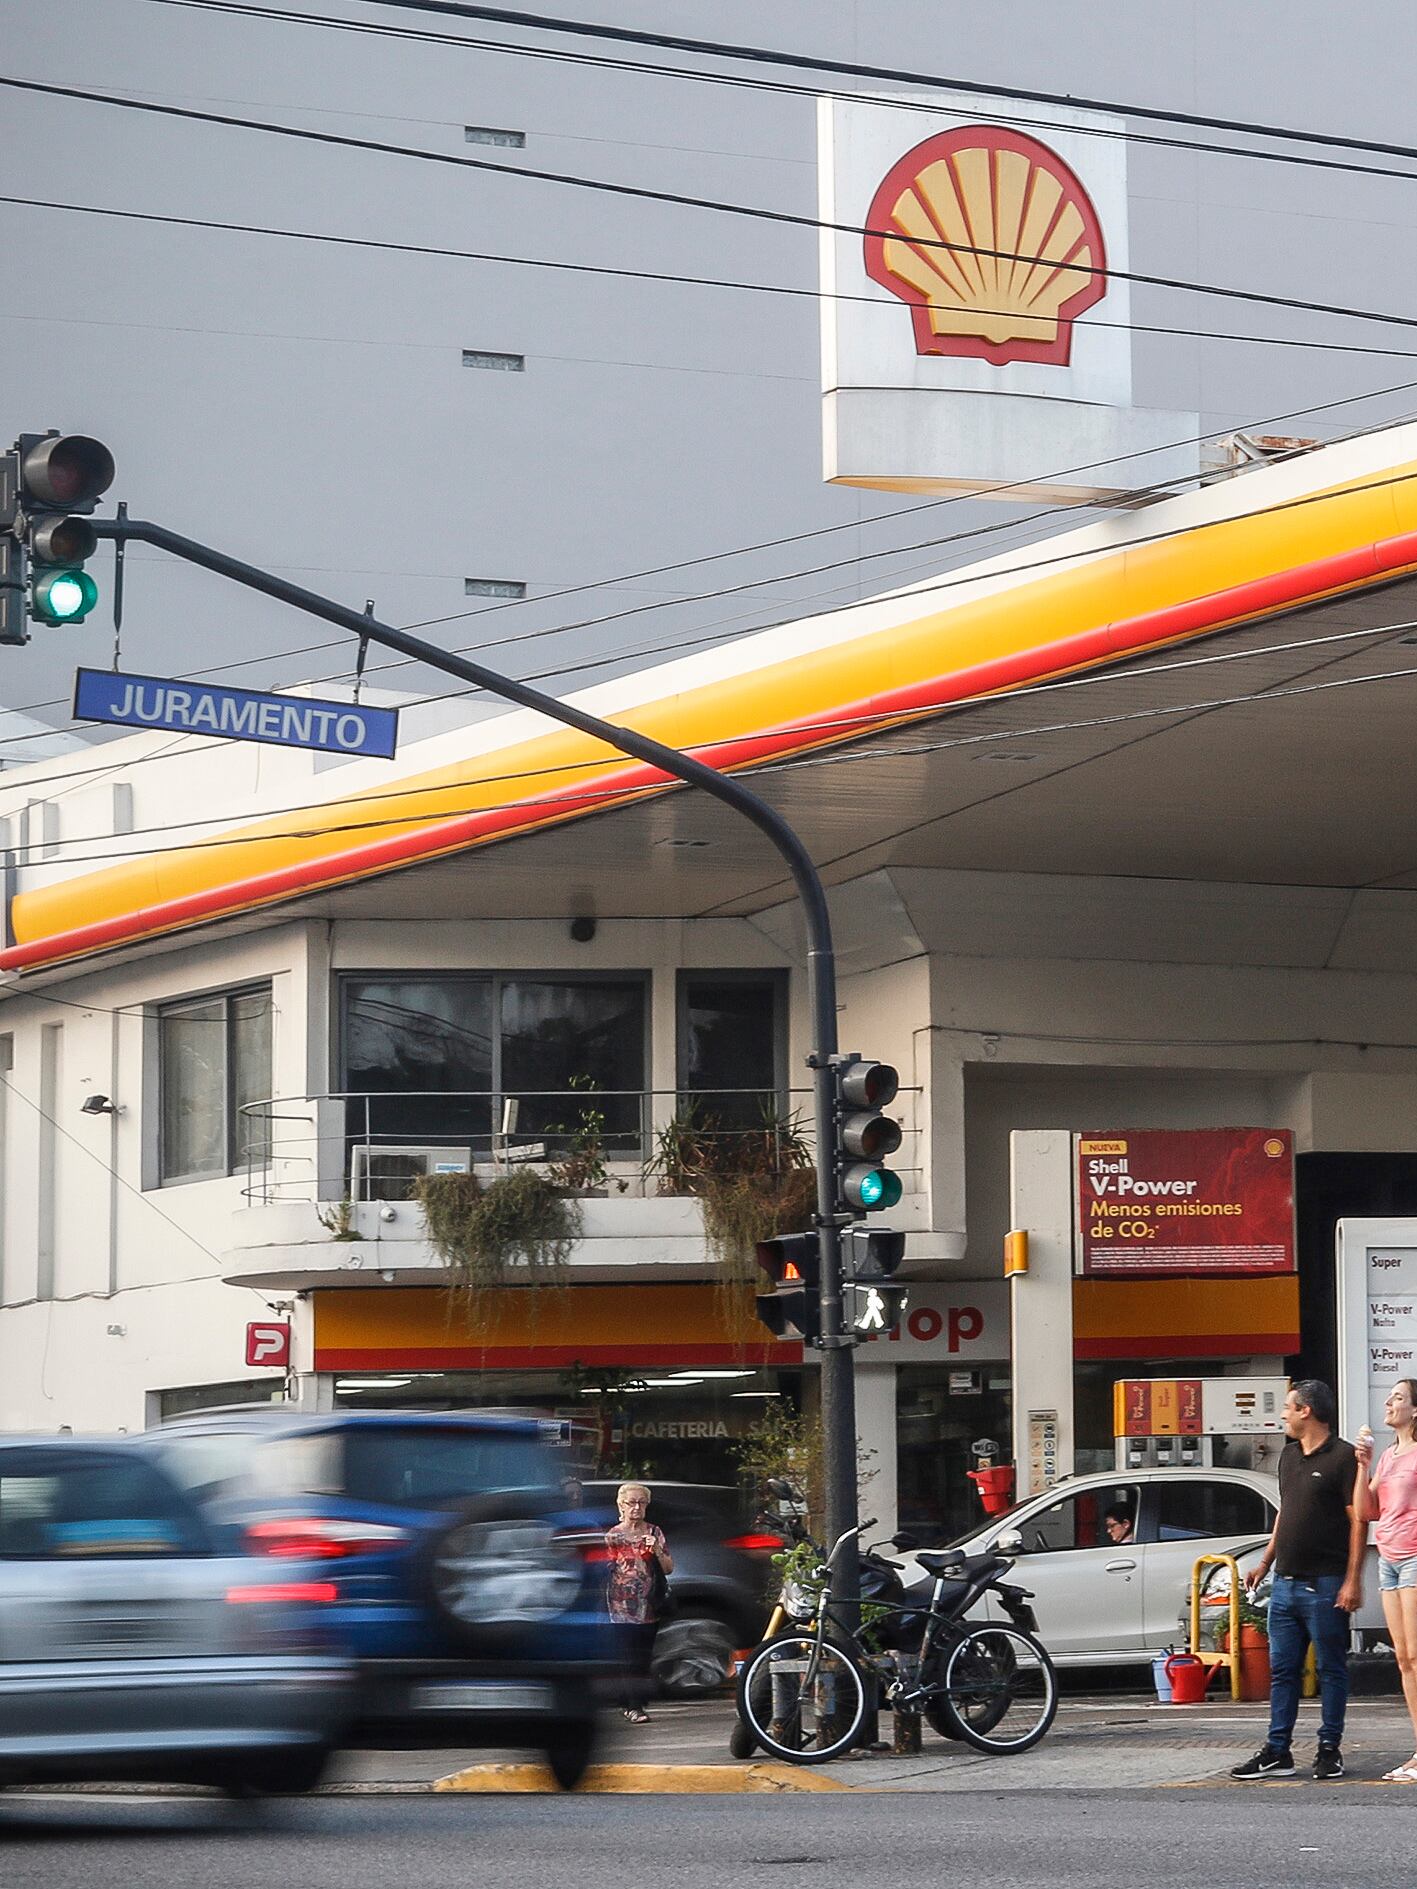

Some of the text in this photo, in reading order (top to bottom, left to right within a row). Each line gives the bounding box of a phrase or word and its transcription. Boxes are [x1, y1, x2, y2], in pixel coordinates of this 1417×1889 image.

[111, 684, 366, 748] JURAMENTO
[1089, 1144, 1121, 1152] NUEVA
[1089, 1159, 1128, 1174] Shell
[1090, 1177, 1197, 1196] V-Power
[1090, 1200, 1242, 1217] Menos emisiones
[1090, 1221, 1114, 1238] de
[1371, 1255, 1402, 1270] Super
[1370, 1303, 1413, 1315] V-Power
[867, 1306, 984, 1353] op
[1370, 1348, 1413, 1360] V-Power
[1372, 1362, 1399, 1372] Diesel
[632, 1421, 729, 1438] CAFETERIA
